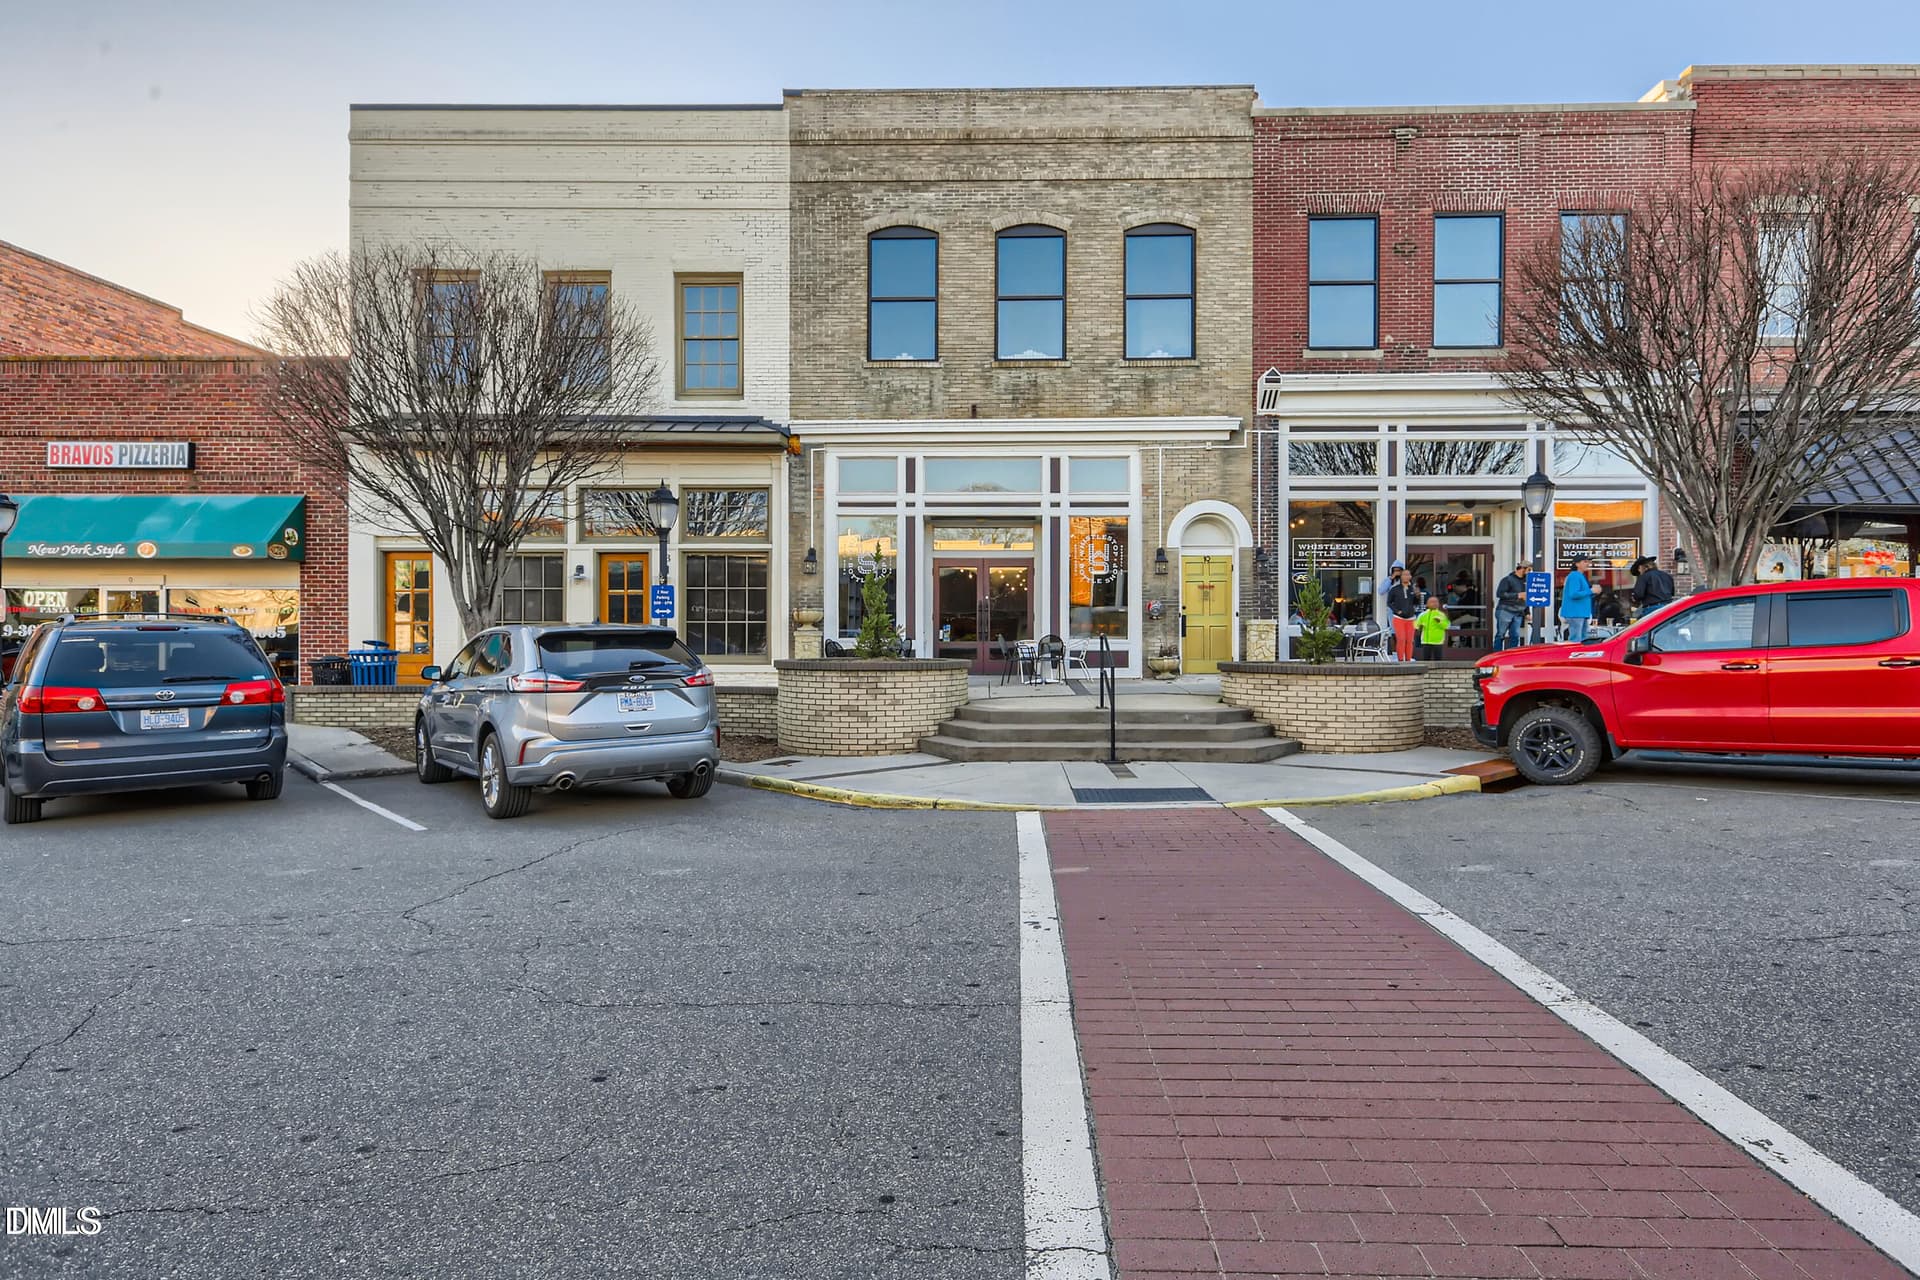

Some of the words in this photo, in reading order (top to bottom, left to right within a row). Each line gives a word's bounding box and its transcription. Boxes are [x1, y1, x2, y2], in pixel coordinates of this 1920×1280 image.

[50, 445, 113, 465] BRAVOS
[118, 445, 187, 465] PIZZERIA
[1432, 523, 1446, 534] 21
[27, 543, 60, 556] New
[61, 543, 95, 556] York
[92, 543, 126, 559] Style
[23, 590, 68, 607] OPEN
[40, 606, 70, 614] PASTA
